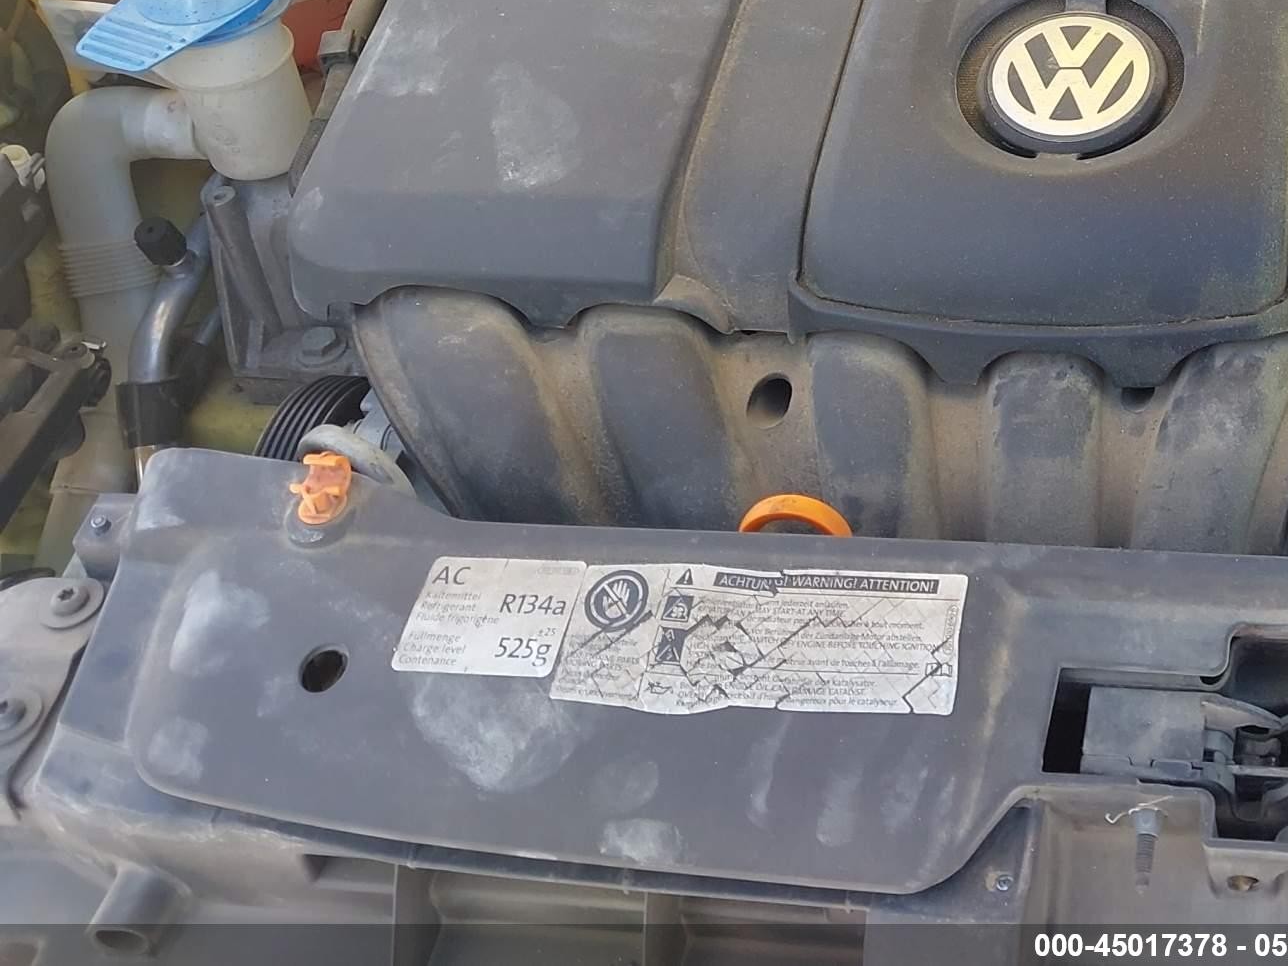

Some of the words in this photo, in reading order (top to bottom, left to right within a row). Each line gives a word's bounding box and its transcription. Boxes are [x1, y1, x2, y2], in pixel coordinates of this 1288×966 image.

[432, 566, 471, 585] AC
[792, 576, 858, 589] WARNING!
[860, 579, 934, 592] ATTENTION!
[500, 593, 566, 615] R134a
[416, 612, 446, 622] Fluide
[403, 642, 441, 655] Charge
[445, 644, 466, 654] level
[494, 637, 551, 667] 525g
[400, 656, 457, 667] Contenance
